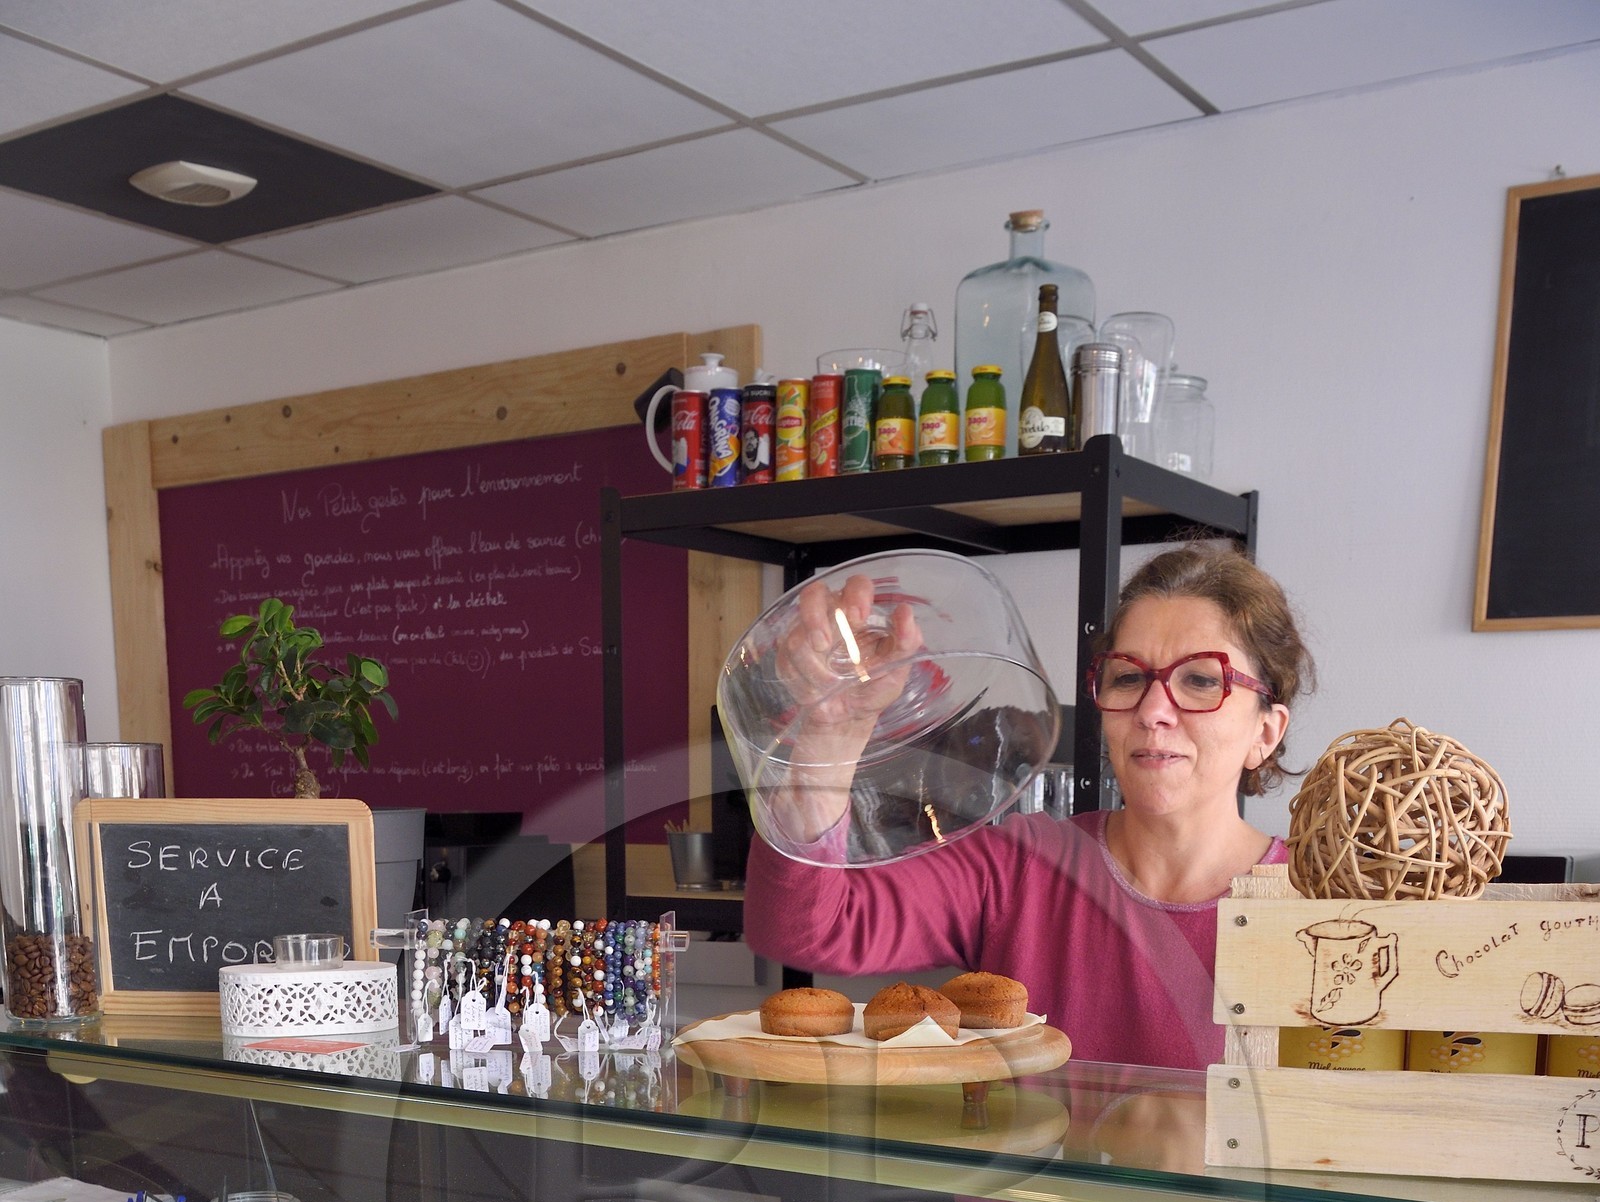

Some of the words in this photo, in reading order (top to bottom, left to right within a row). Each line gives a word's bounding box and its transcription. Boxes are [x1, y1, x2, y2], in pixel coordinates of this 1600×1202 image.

[317, 483, 363, 517] Petits
[418, 486, 455, 520] pour
[396, 547, 421, 560] vous
[505, 532, 522, 550] de
[127, 840, 305, 871] SERVICE
[199, 882, 224, 910] A
[1435, 922, 1520, 979] Chocolat
